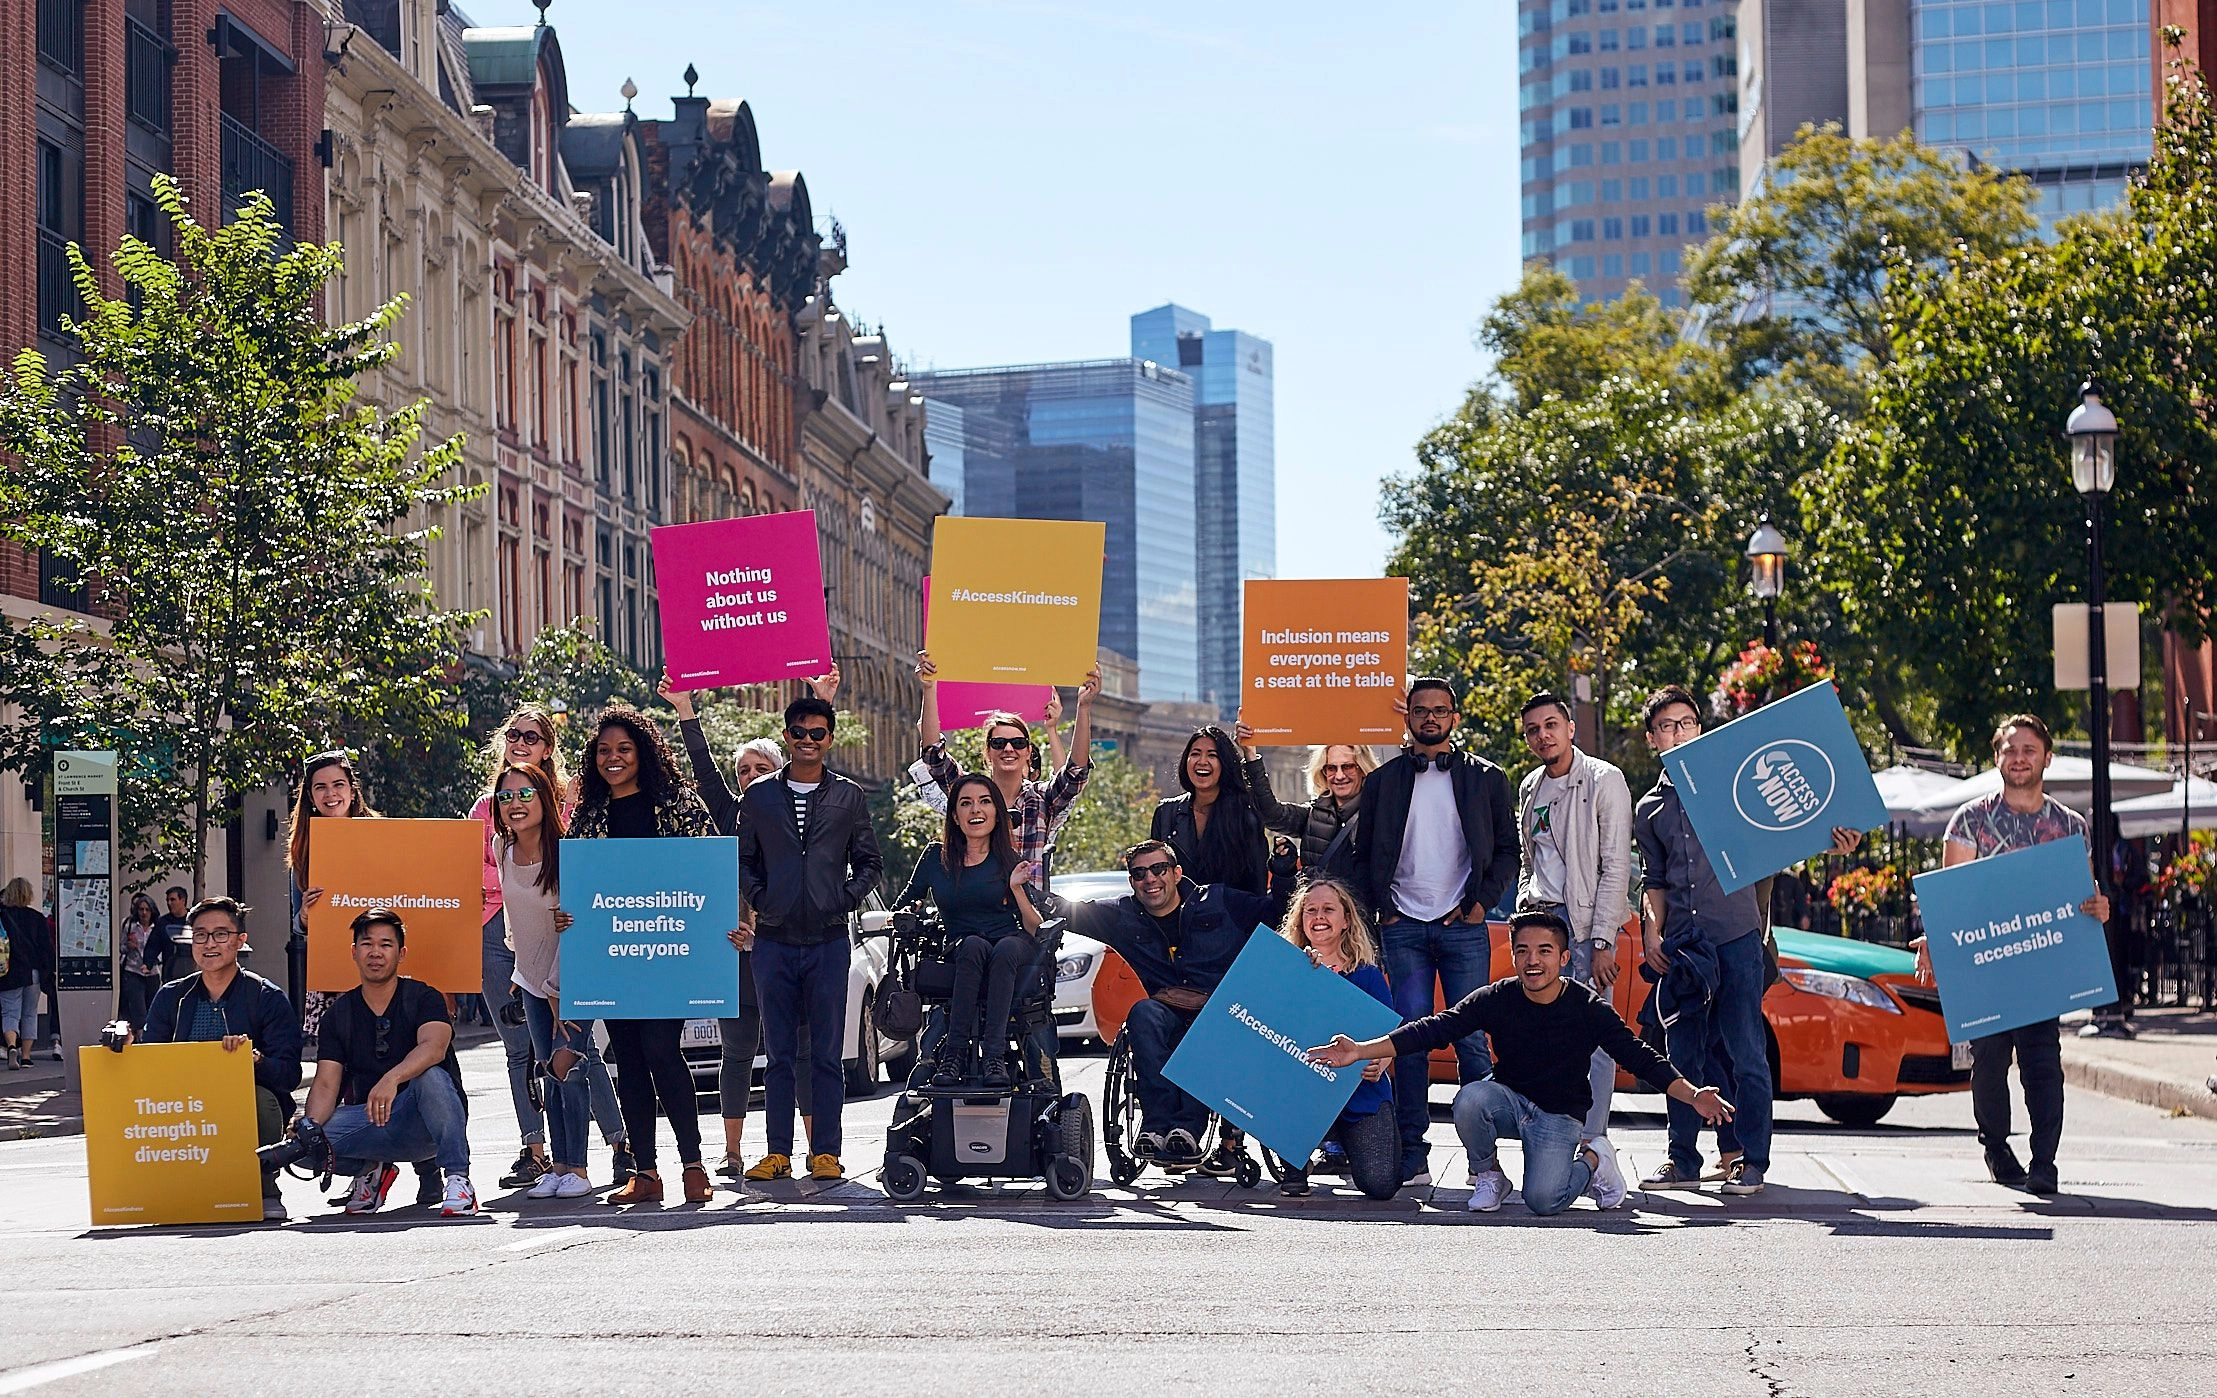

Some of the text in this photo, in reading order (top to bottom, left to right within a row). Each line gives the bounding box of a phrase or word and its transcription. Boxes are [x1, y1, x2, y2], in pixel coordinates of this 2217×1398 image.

[706, 567, 771, 586] Nothing
[706, 590, 777, 608] about us
[952, 589, 1077, 605] #AccessKindness
[701, 611, 787, 631] without us
[1262, 629, 1389, 644] Inclusion means
[1270, 652, 1381, 669] everyone gets
[680, 670, 720, 679] #AccessKindness
[1255, 672, 1395, 688] a seat at the table
[1777, 762, 1820, 811] ACCESS
[1757, 775, 1804, 823] NOW
[331, 894, 461, 910] #AccessKindness
[592, 891, 705, 911] Accessibility
[612, 916, 686, 933] benefits
[1952, 903, 2074, 946] You had me at
[609, 944, 689, 960] everyone
[1973, 931, 2064, 965] accessible
[135, 1096, 204, 1114] There is
[1224, 1097, 1254, 1119] accessnow.me
[124, 1120, 217, 1141] strength in
[135, 1144, 210, 1164] diversity
